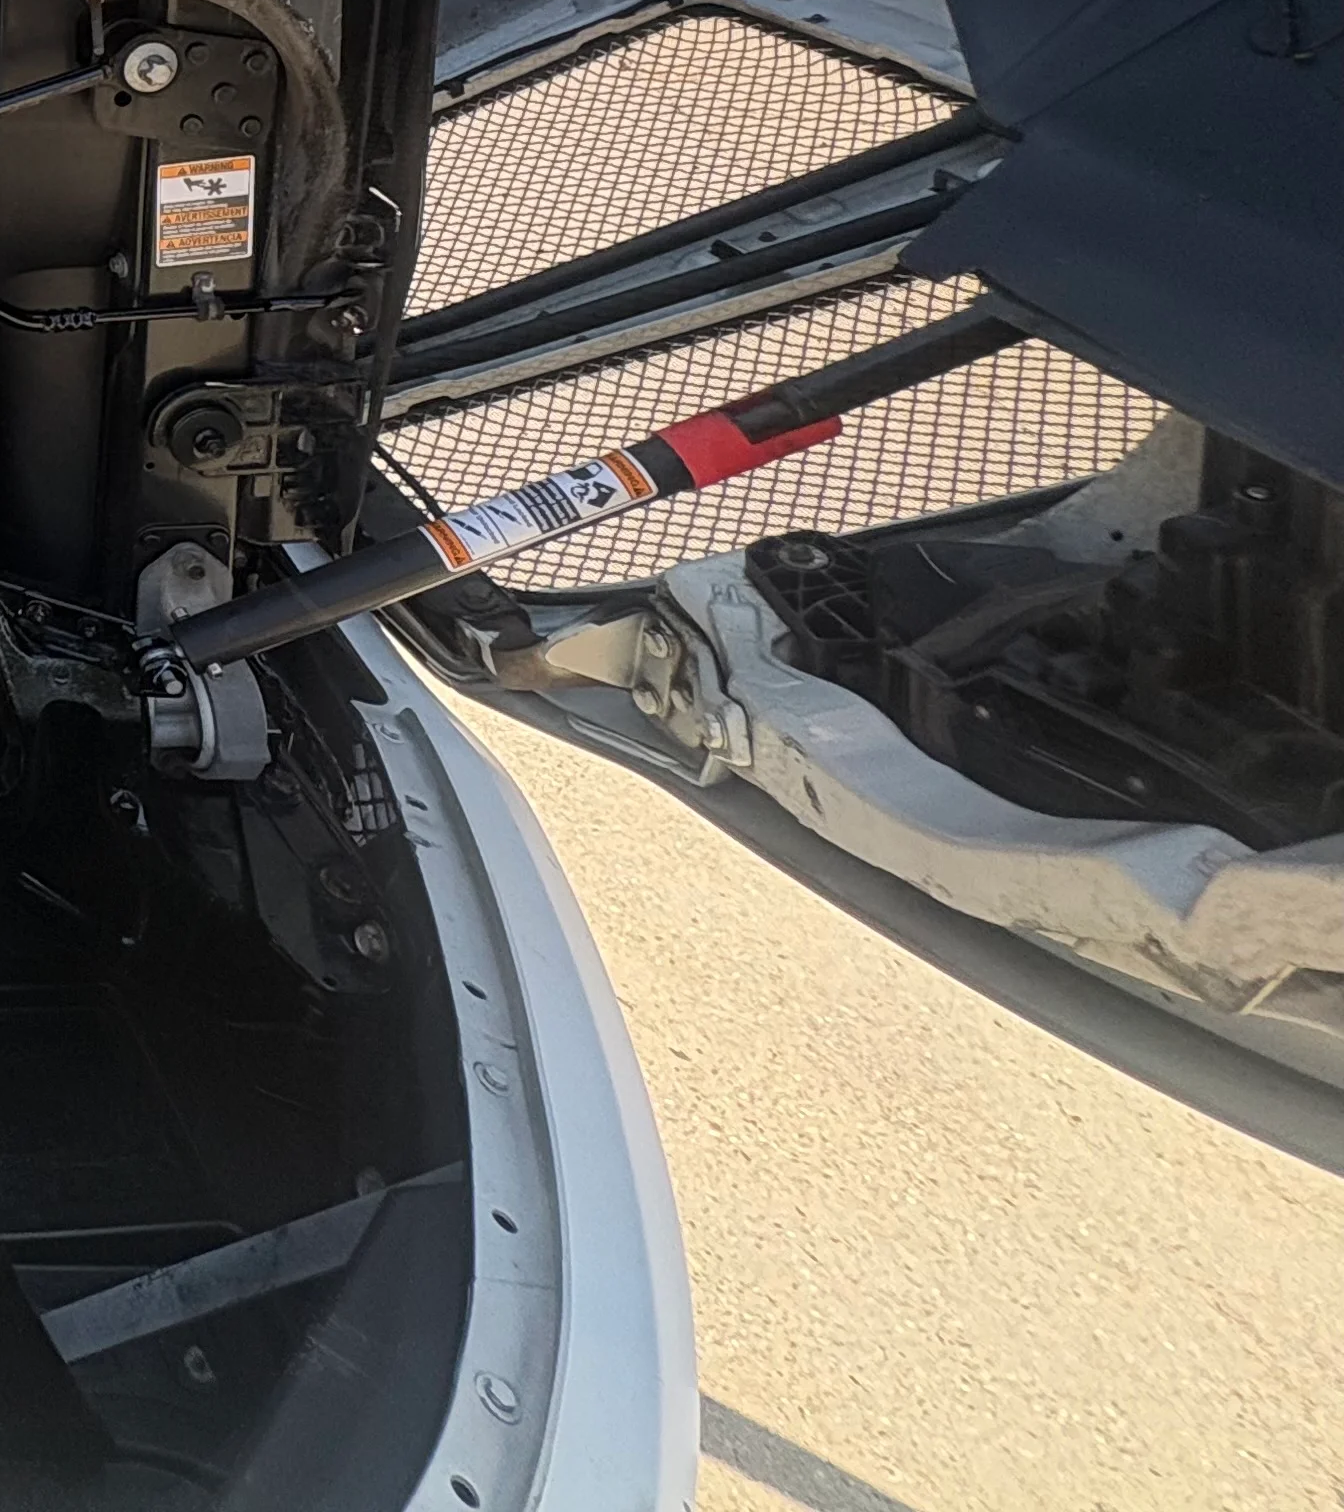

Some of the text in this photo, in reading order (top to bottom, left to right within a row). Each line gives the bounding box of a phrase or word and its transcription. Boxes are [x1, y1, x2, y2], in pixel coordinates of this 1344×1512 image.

[189, 161, 234, 174] WARNING
[174, 206, 248, 224] AVERTISSEMENT
[178, 232, 243, 248] ADVERTENCIA
